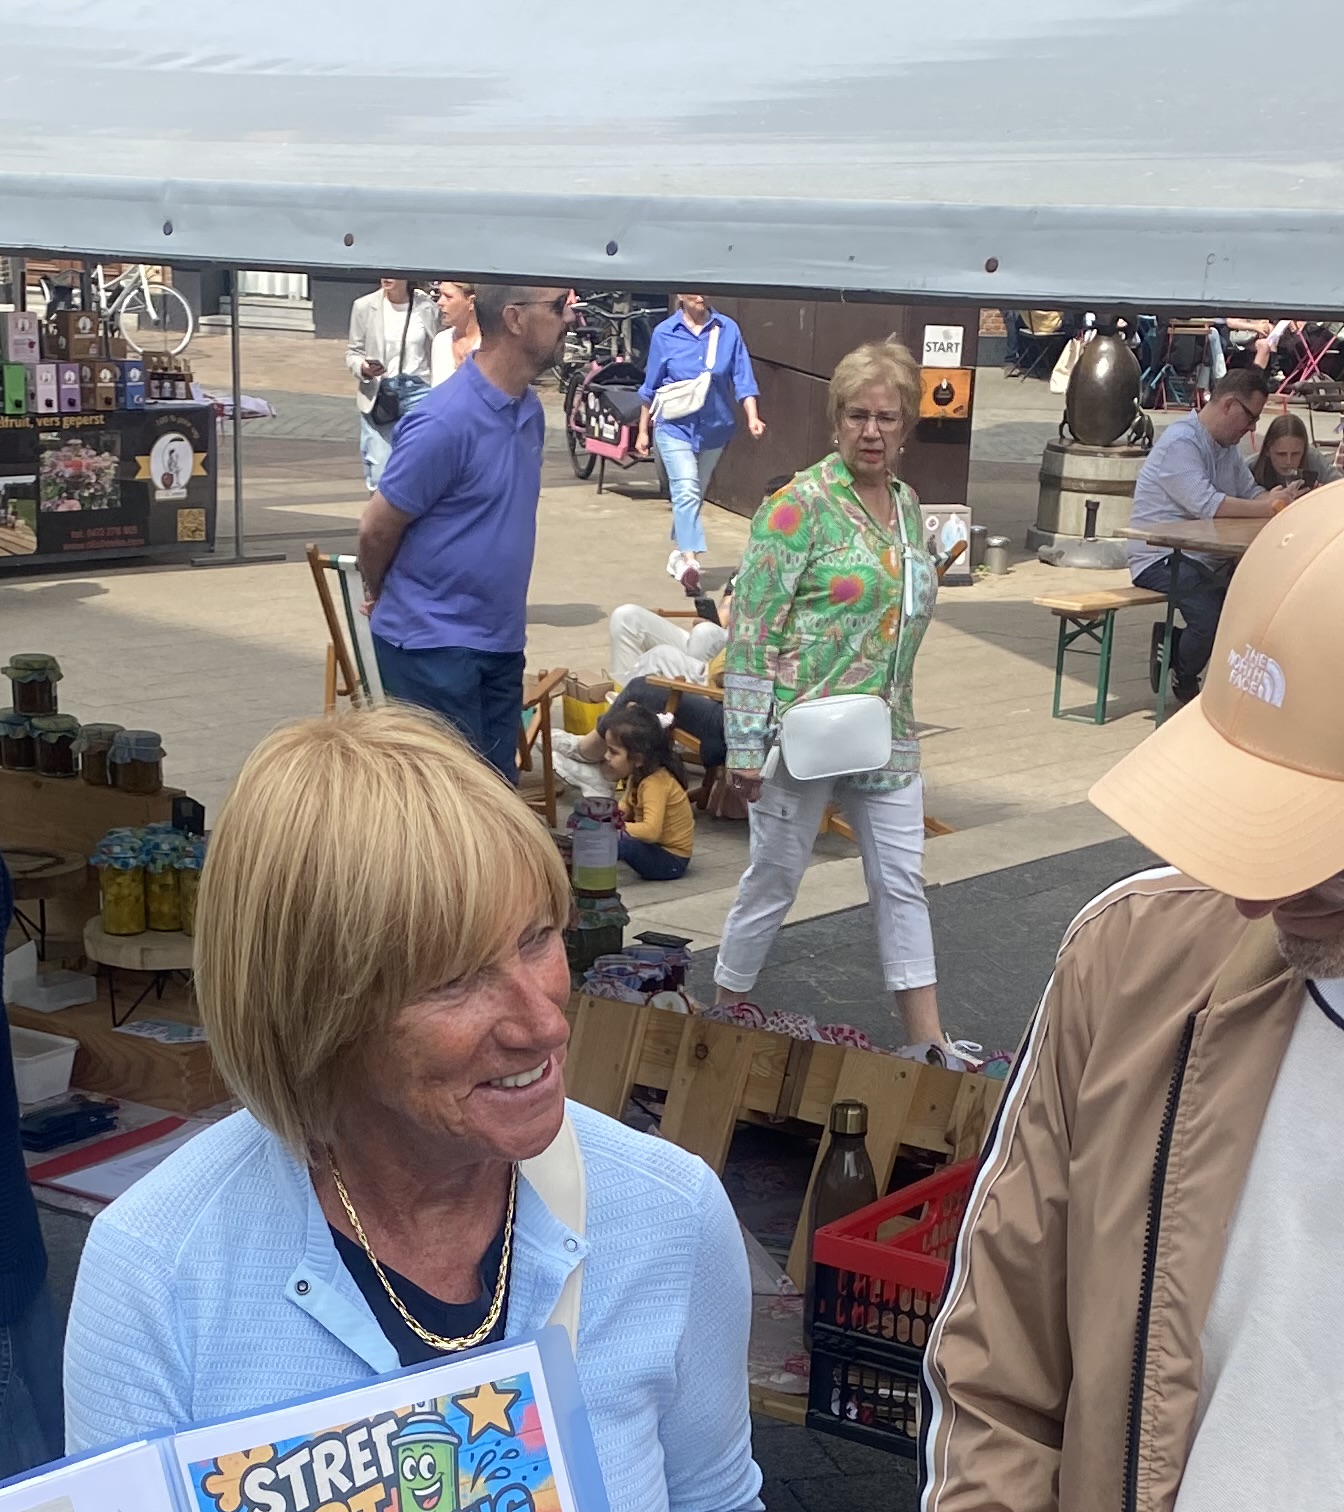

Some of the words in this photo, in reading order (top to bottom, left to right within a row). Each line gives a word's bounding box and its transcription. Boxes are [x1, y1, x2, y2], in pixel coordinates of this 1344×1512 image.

[925, 341, 960, 353] START
[36, 417, 61, 427] vers
[62, 414, 105, 429] geperst
[1227, 648, 1264, 684] NORTH
[1246, 643, 1268, 669] THE
[1228, 668, 1258, 696] FACE
